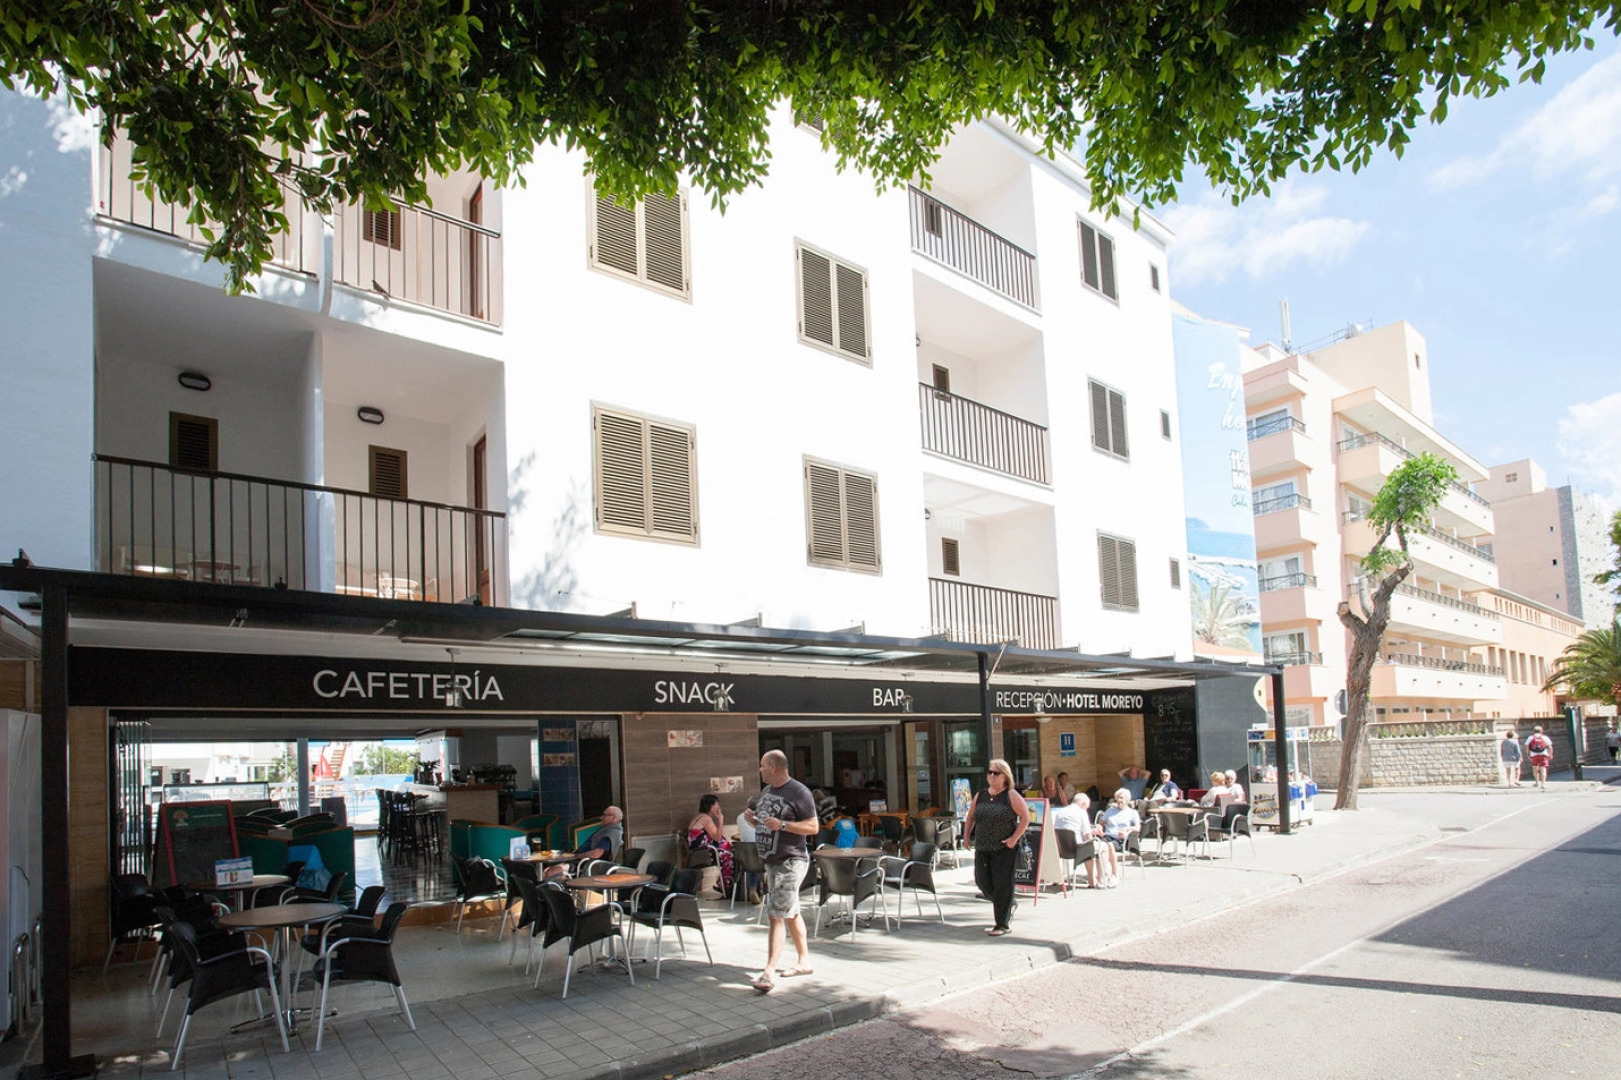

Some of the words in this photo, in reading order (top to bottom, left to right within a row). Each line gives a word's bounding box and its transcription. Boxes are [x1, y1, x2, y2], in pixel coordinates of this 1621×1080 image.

[1207, 362, 1243, 400] Enj
[1221, 402, 1246, 429] ho
[312, 669, 504, 701] CAFETERÍA
[654, 680, 735, 704] SNACK
[873, 687, 906, 707] BAR
[1067, 693, 1100, 709] HOTEL
[1102, 694, 1143, 709] MOREYO
